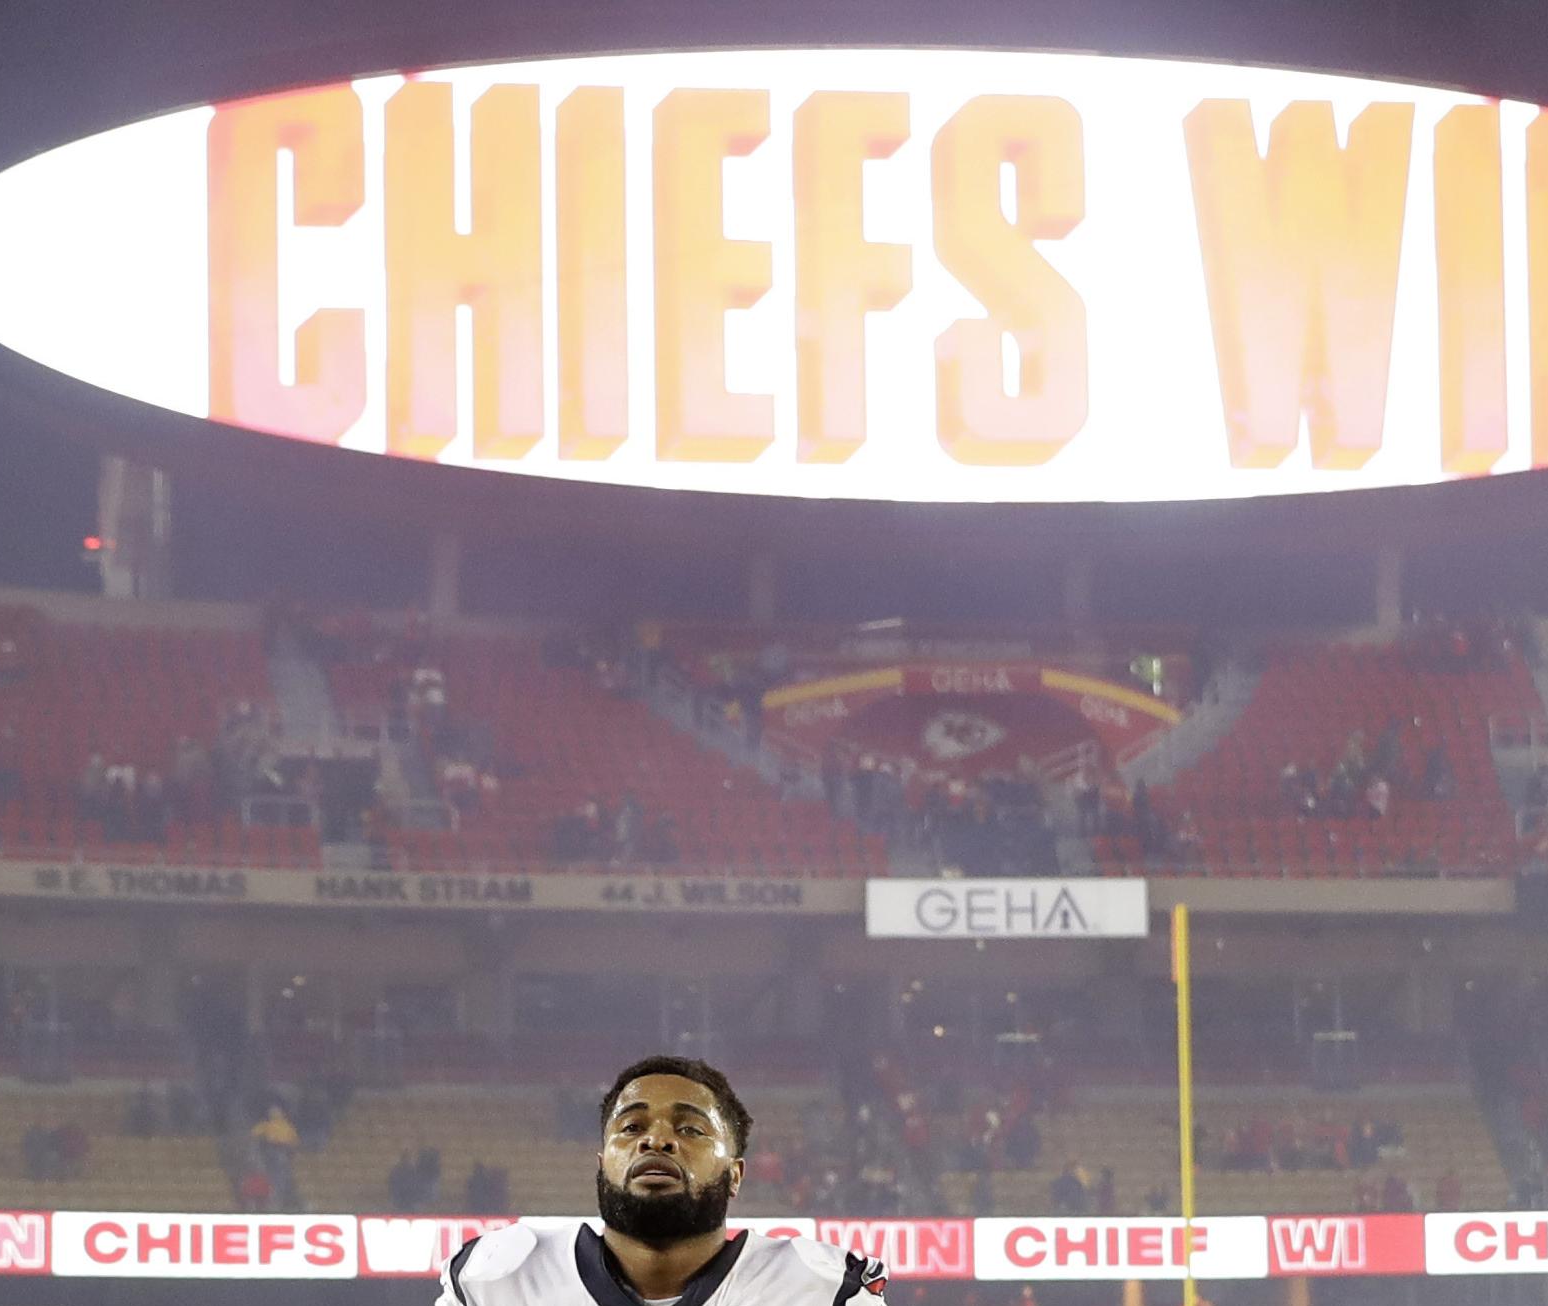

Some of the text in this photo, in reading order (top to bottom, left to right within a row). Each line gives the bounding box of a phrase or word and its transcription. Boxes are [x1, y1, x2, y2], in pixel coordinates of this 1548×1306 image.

[207, 78, 1089, 468] CHIEFS
[109, 871, 247, 899] THOMAS
[315, 876, 532, 906] HANK STRAM
[679, 883, 803, 907] WILSON
[915, 887, 1091, 932] GEHA
[83, 1221, 346, 1268] CHIEFS
[1003, 1225, 1208, 1269] CHIEF
[1271, 1217, 1366, 1271] WI
